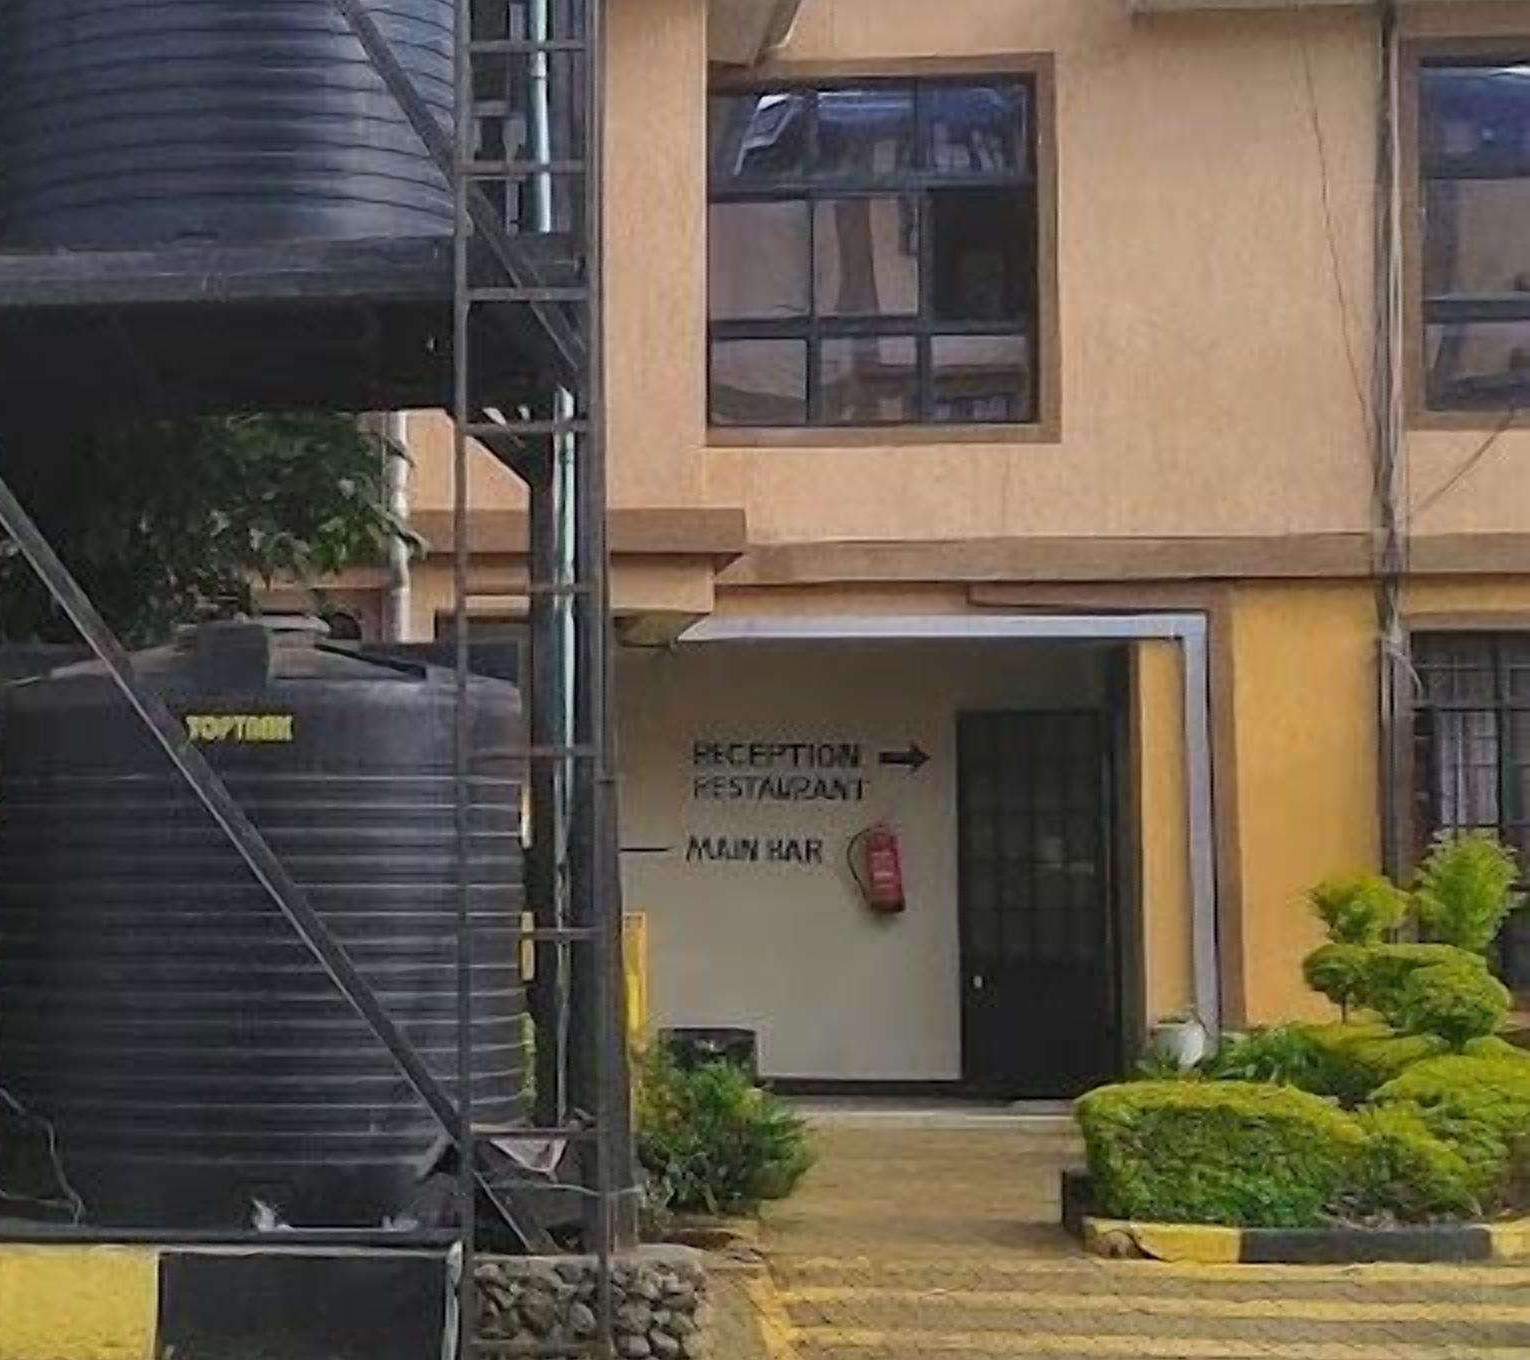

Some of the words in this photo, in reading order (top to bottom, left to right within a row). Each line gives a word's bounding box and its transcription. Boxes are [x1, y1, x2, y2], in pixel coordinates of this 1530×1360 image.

[185, 715, 292, 741] TOPTANK
[693, 742, 860, 768] RECEPTION
[693, 776, 867, 800] RESTAURANT
[686, 836, 760, 862] MAIN
[769, 839, 823, 863] BAR
